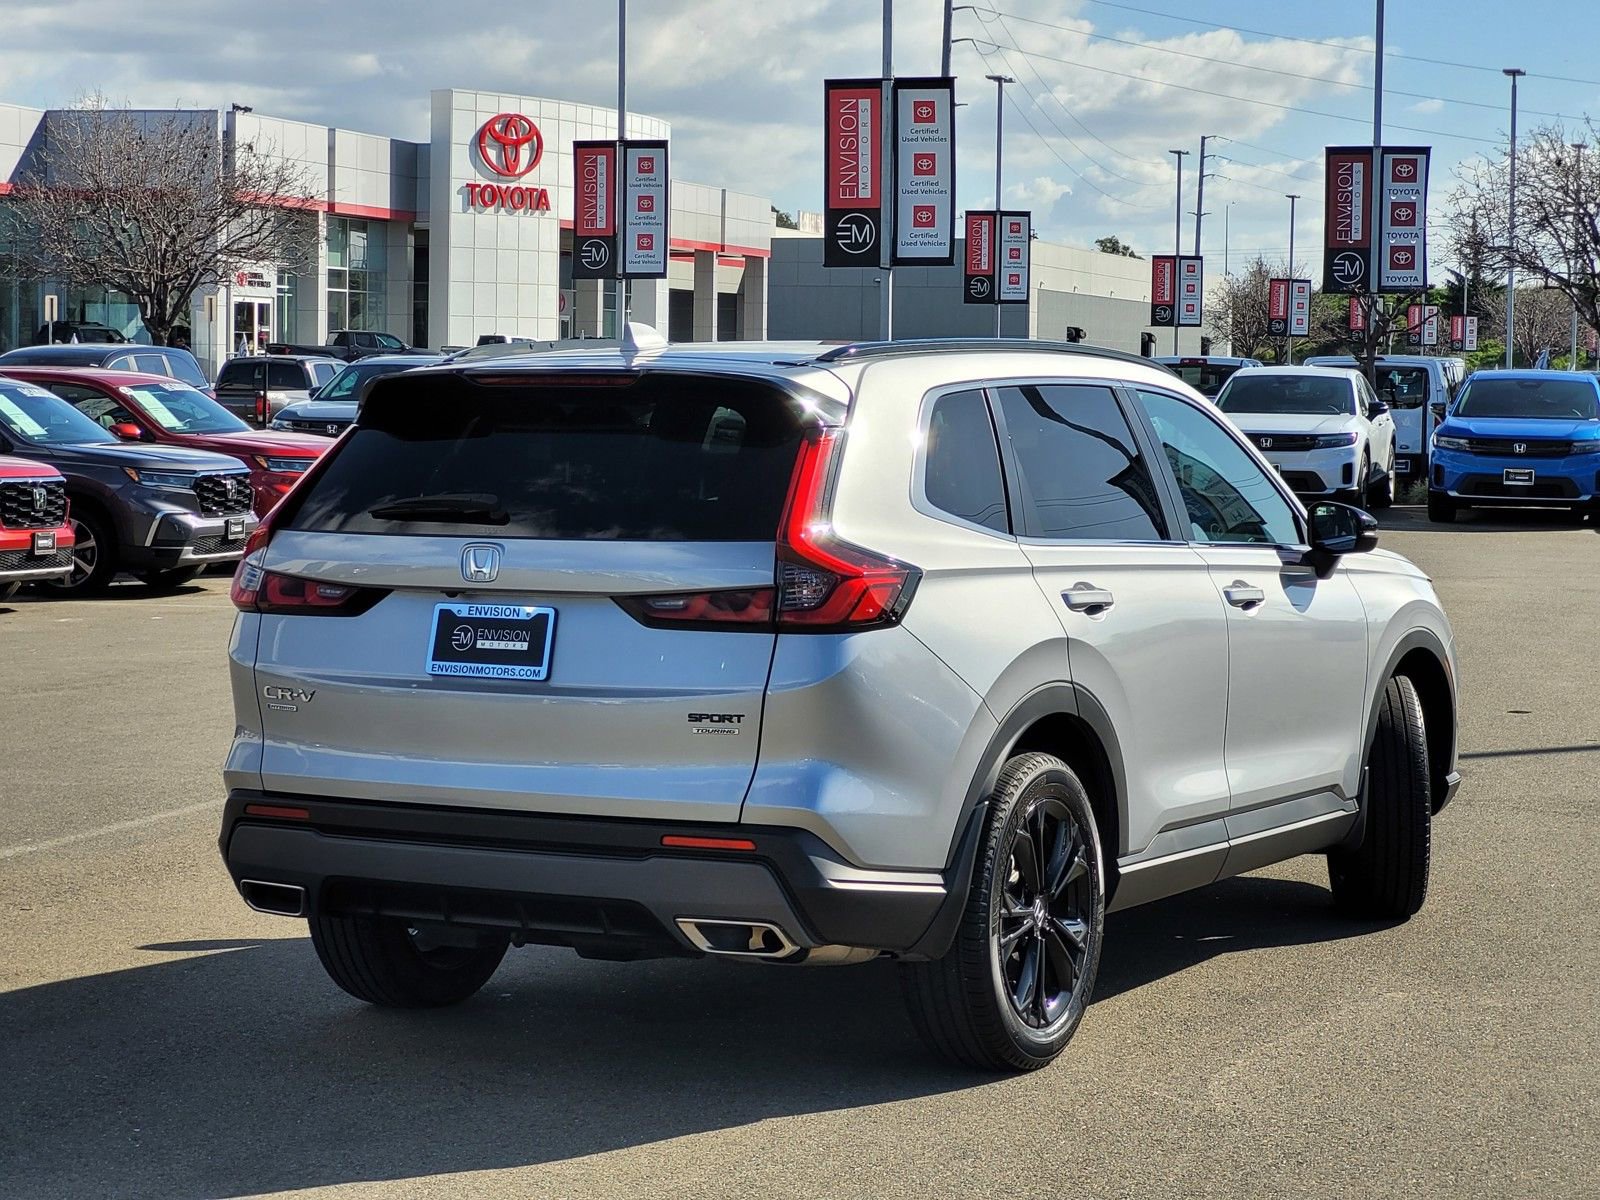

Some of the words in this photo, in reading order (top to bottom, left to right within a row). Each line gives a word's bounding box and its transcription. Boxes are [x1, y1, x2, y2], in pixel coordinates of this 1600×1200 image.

[839, 98, 857, 199] ENVISION
[465, 183, 551, 211] TOYOTA
[583, 155, 597, 229] ENVISION
[1336, 162, 1352, 240] ENVISION
[971, 220, 982, 271] ENVISION
[467, 605, 520, 618] ENVISION
[476, 628, 531, 641] ENVISION
[431, 663, 541, 678] ENVISIONMOTORS.COM
[263, 685, 317, 703] CR-V
[687, 712, 746, 724] SPORT
